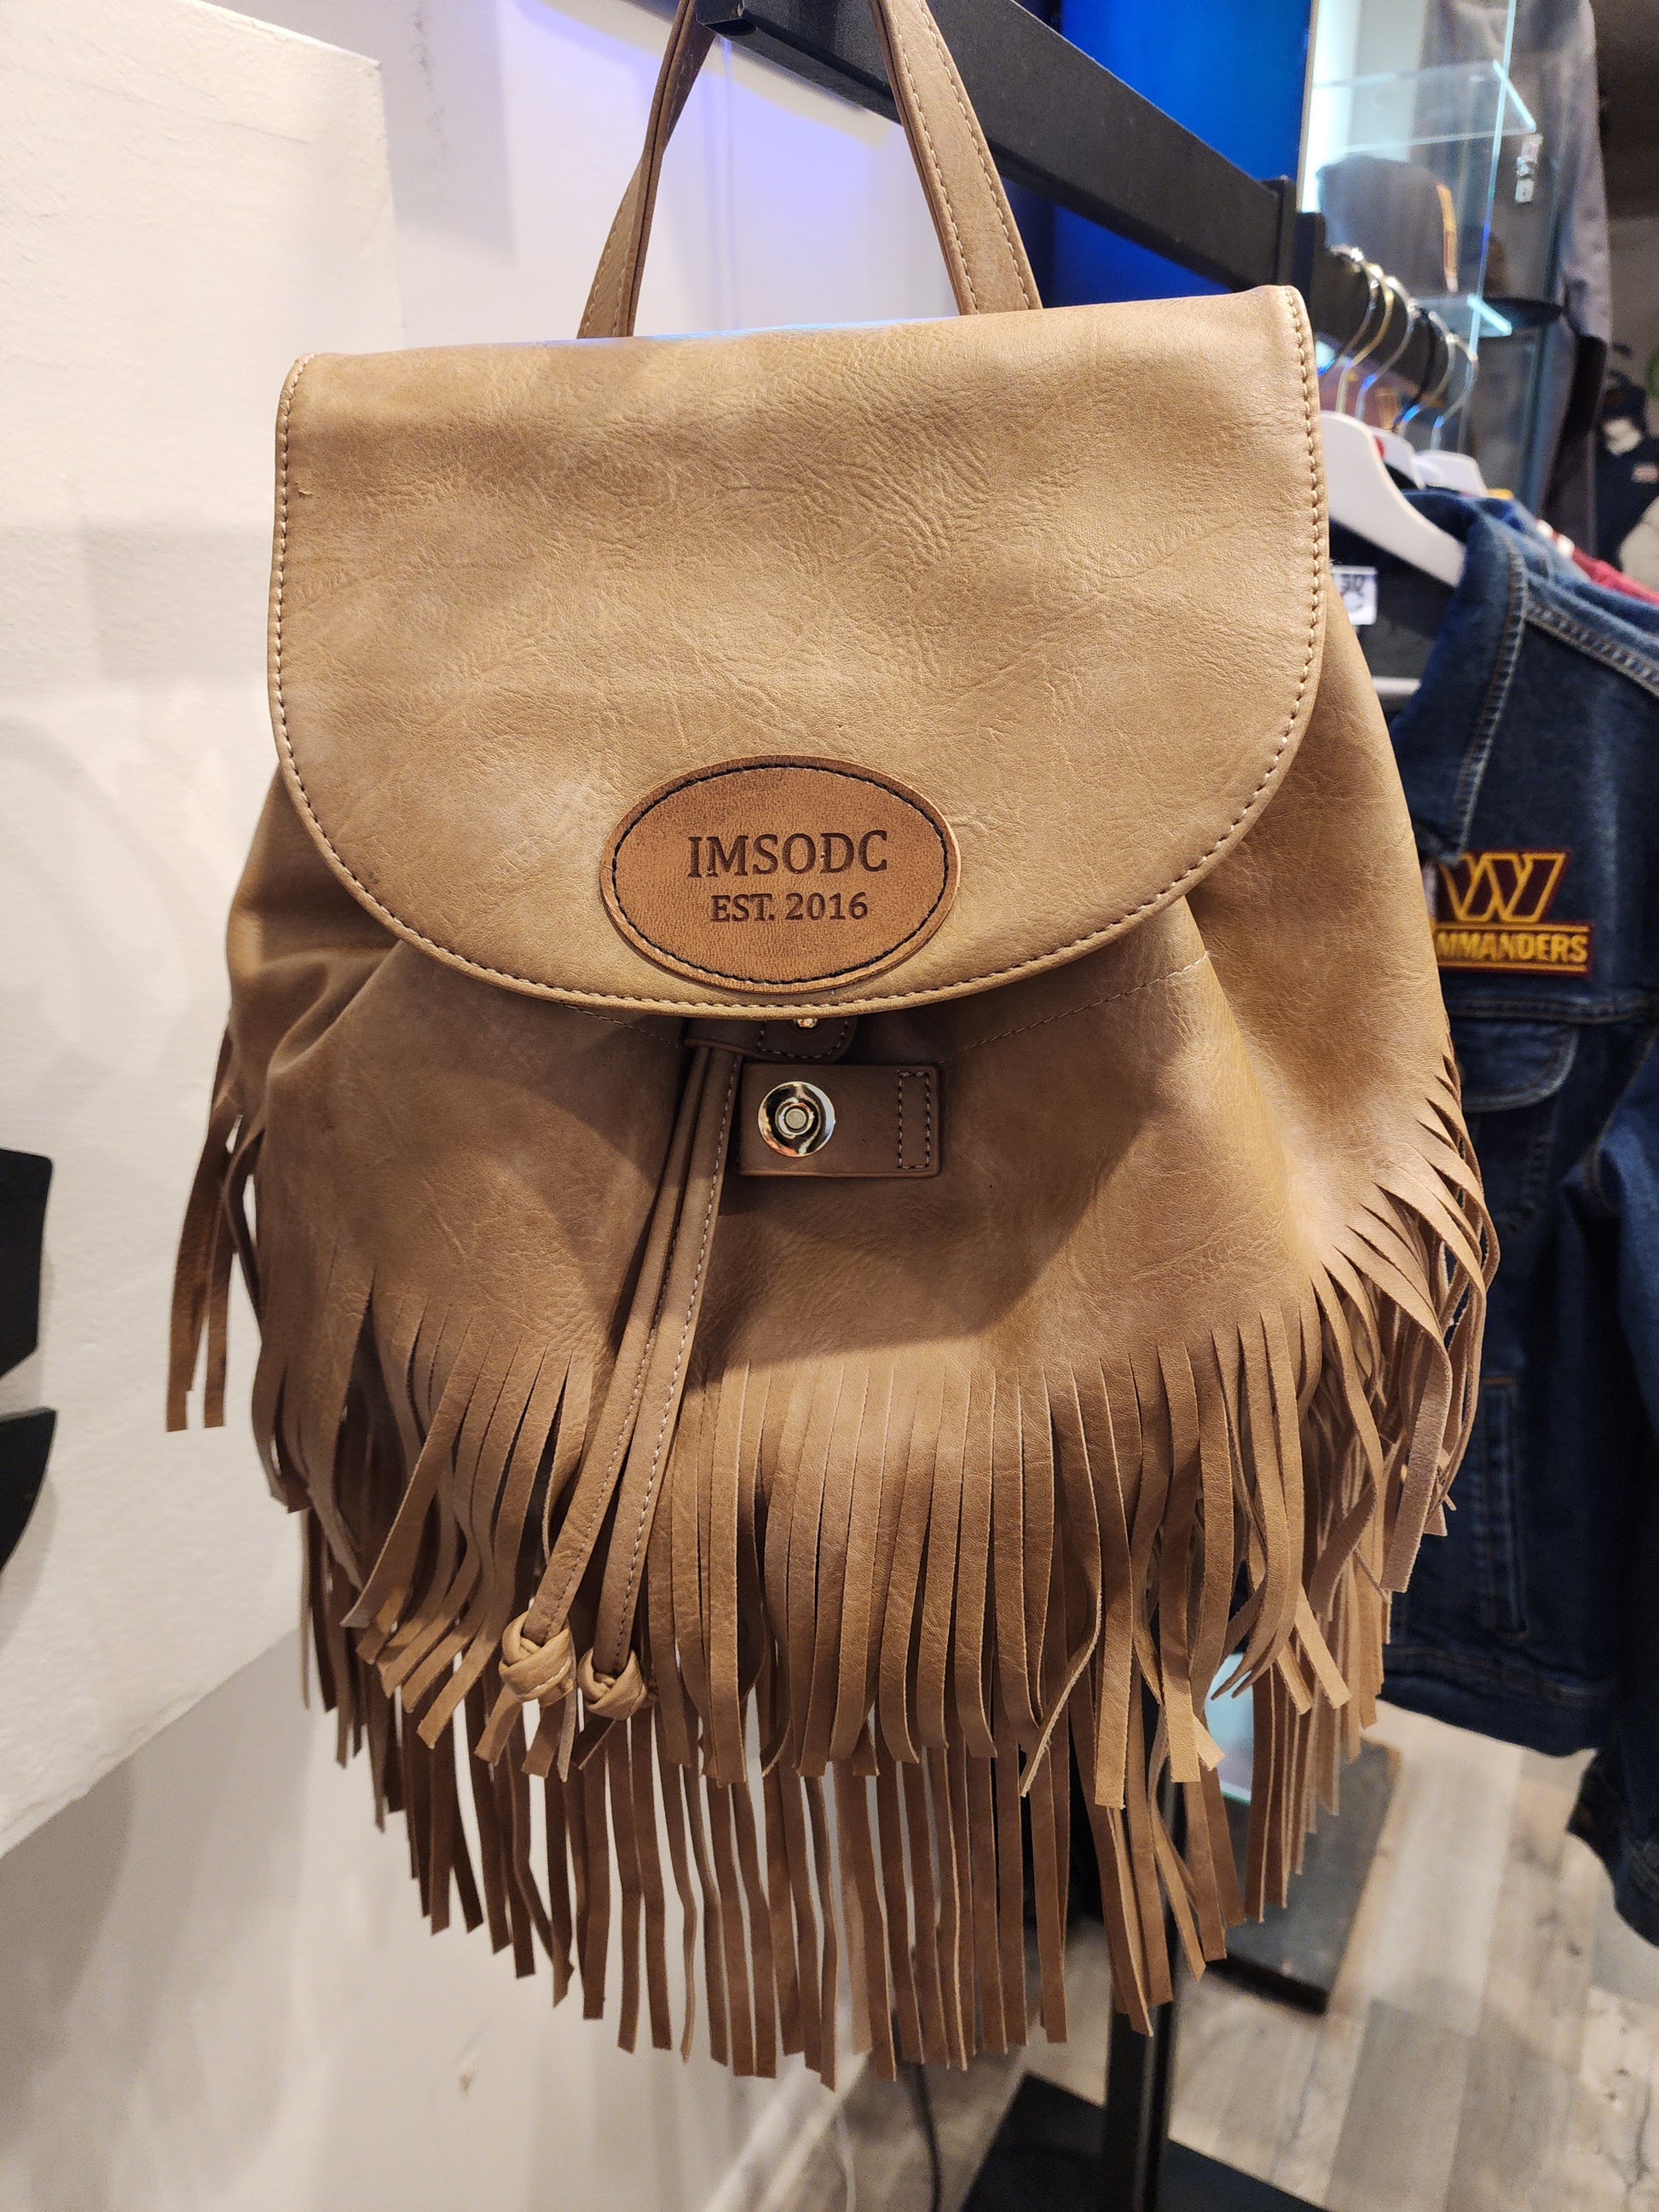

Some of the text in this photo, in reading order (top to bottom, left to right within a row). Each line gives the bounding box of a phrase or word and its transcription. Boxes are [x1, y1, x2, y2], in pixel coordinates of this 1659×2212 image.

[687, 830, 887, 878] IMSODC
[711, 892, 868, 922] EST. 2016
[1435, 933, 1589, 963] MMANDERS
